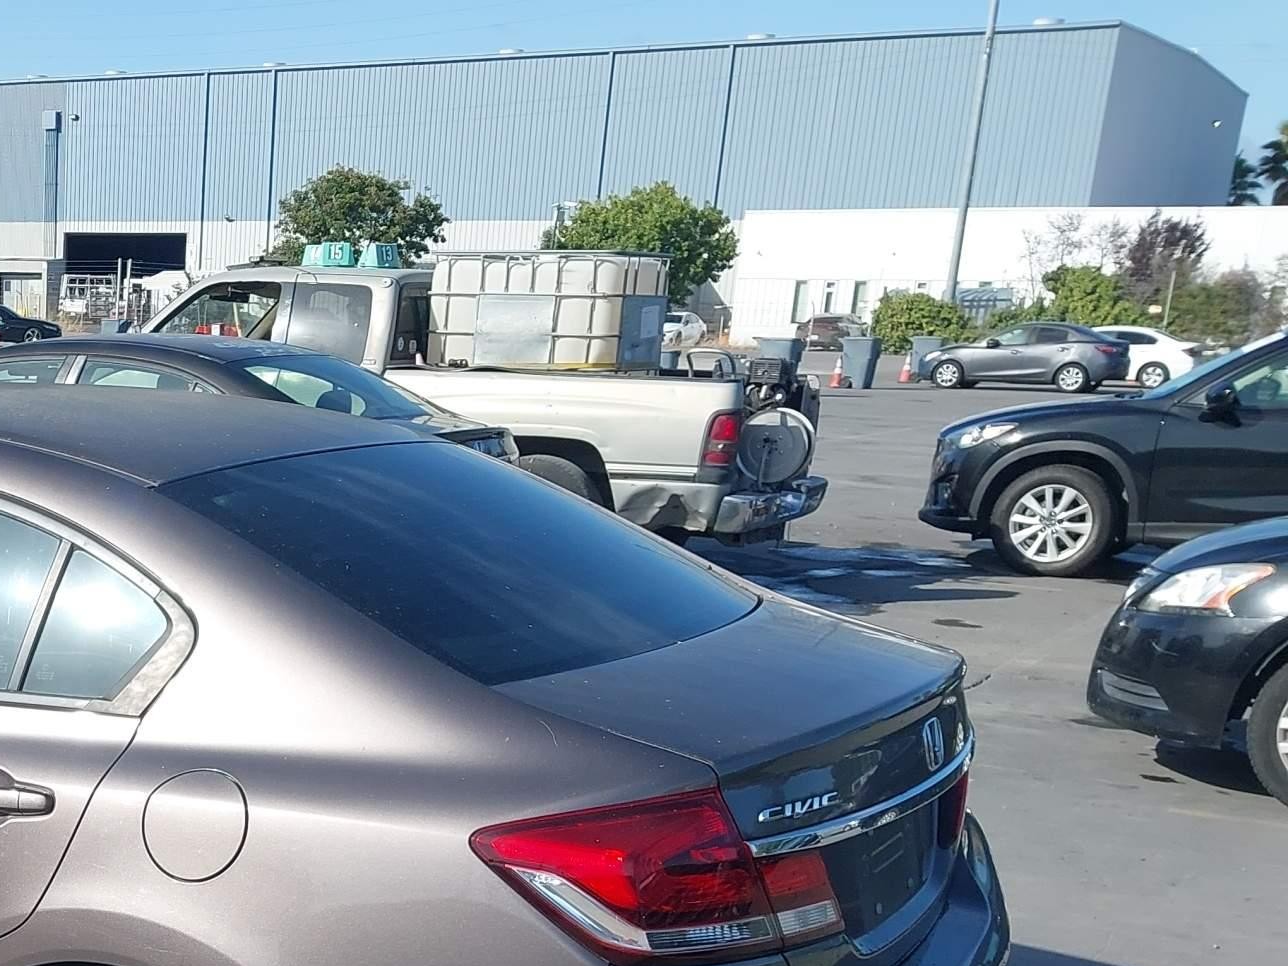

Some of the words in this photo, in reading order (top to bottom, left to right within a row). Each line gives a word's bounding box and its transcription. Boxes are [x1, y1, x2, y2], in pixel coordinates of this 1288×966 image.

[328, 244, 343, 260] 15
[382, 245, 393, 261] 13
[758, 791, 839, 823] CIVIC
